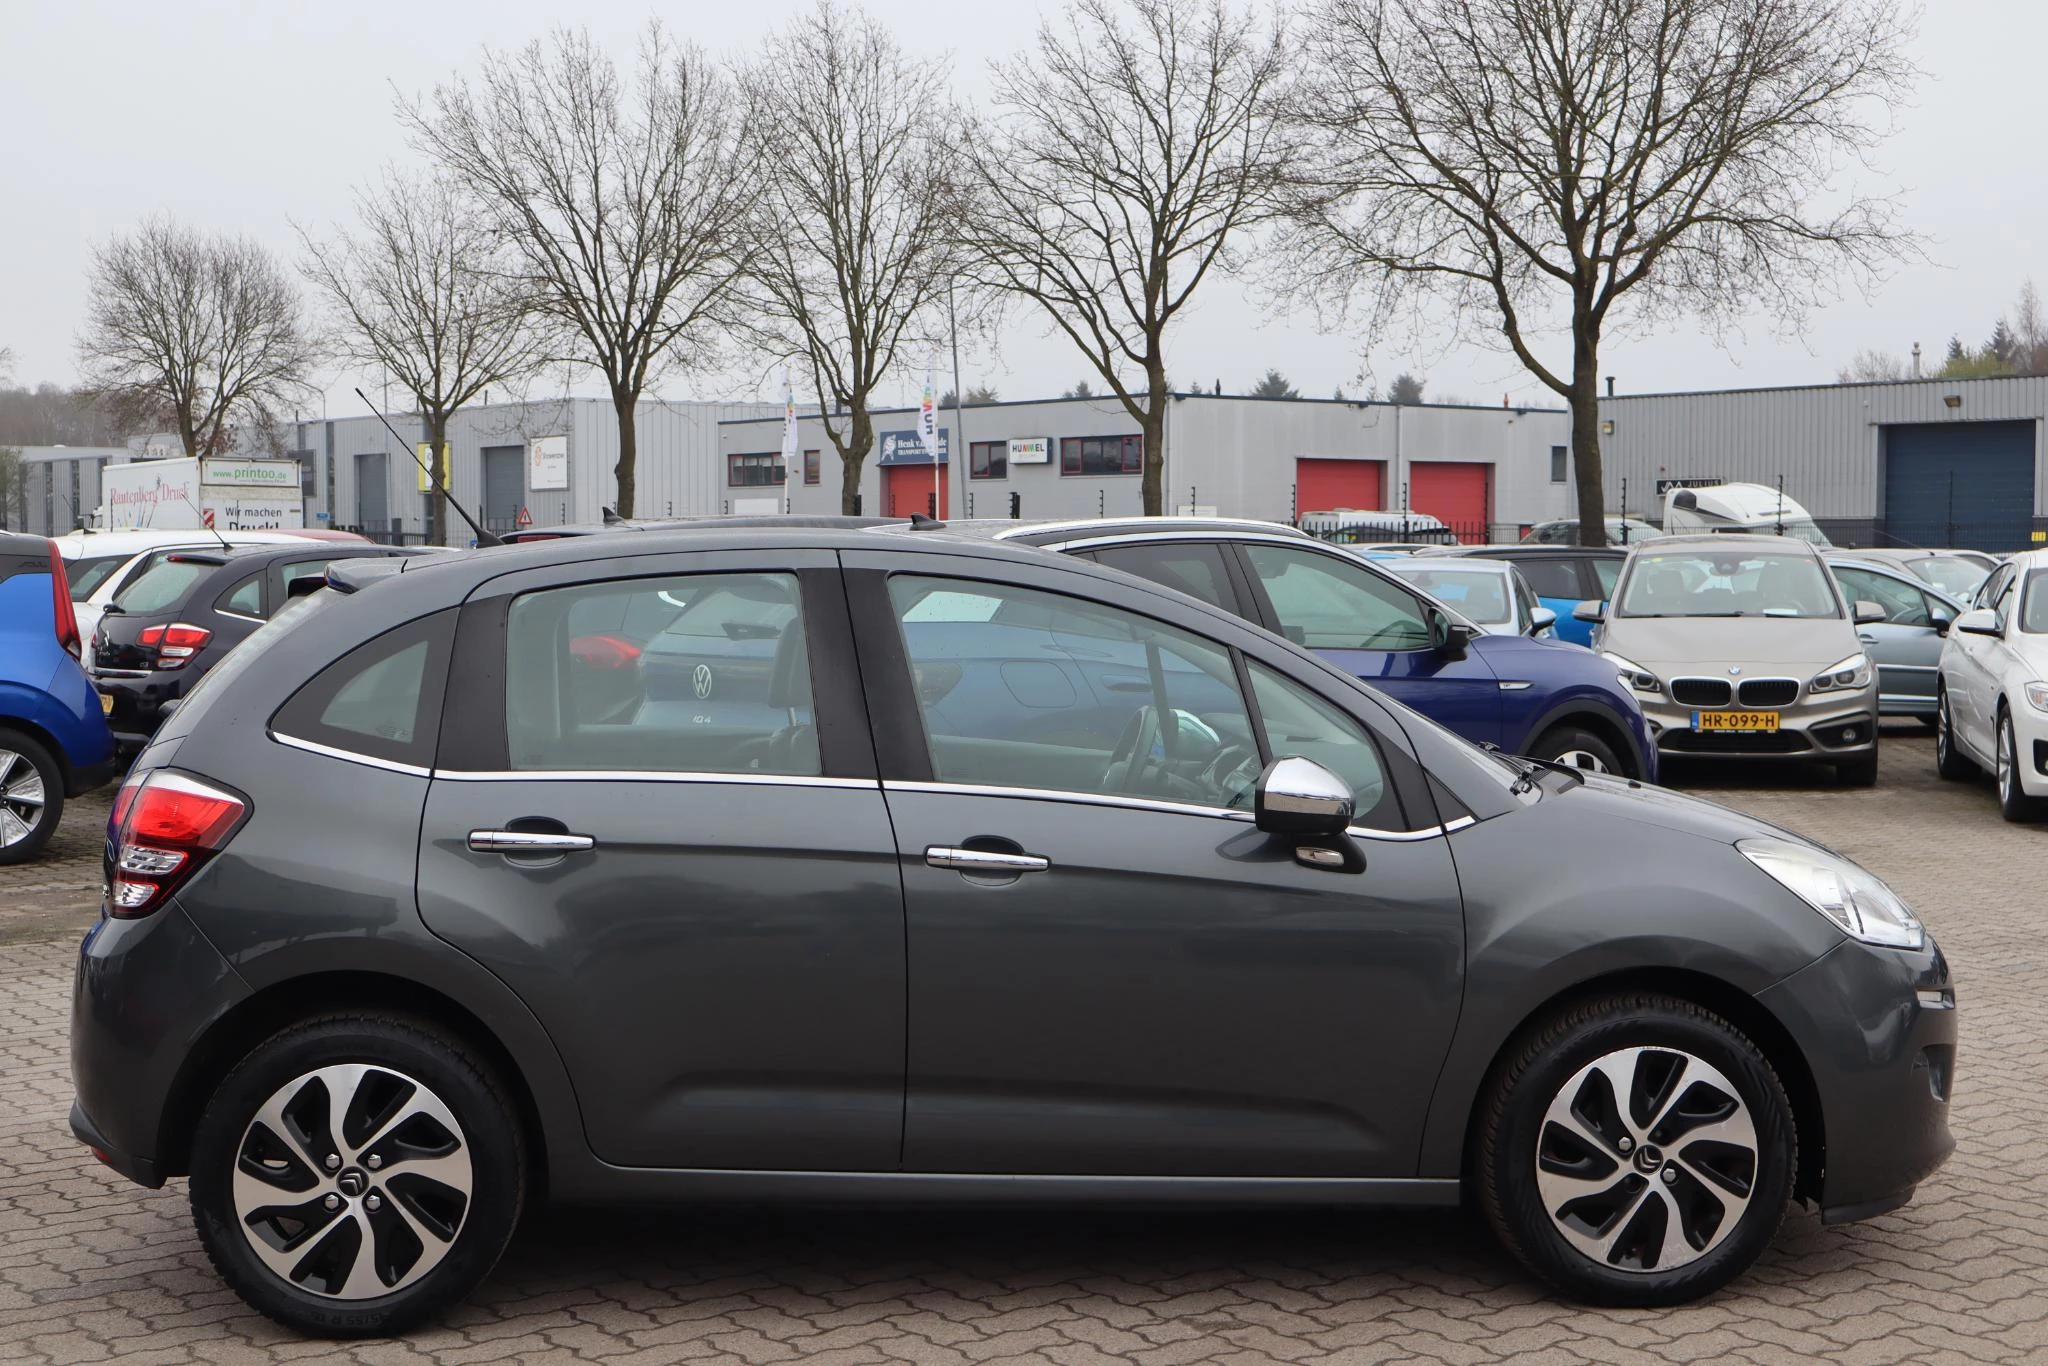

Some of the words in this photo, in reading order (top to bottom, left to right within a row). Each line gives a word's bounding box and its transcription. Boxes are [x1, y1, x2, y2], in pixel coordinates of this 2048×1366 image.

[897, 439, 915, 449] Henk
[1012, 443, 1045, 453] HUMMEL
[212, 467, 287, 480] www.printoo.de
[162, 482, 189, 501] Druck
[225, 507, 241, 518] Wir
[244, 507, 282, 518] machen
[1702, 714, 1775, 727] HR-099-H
